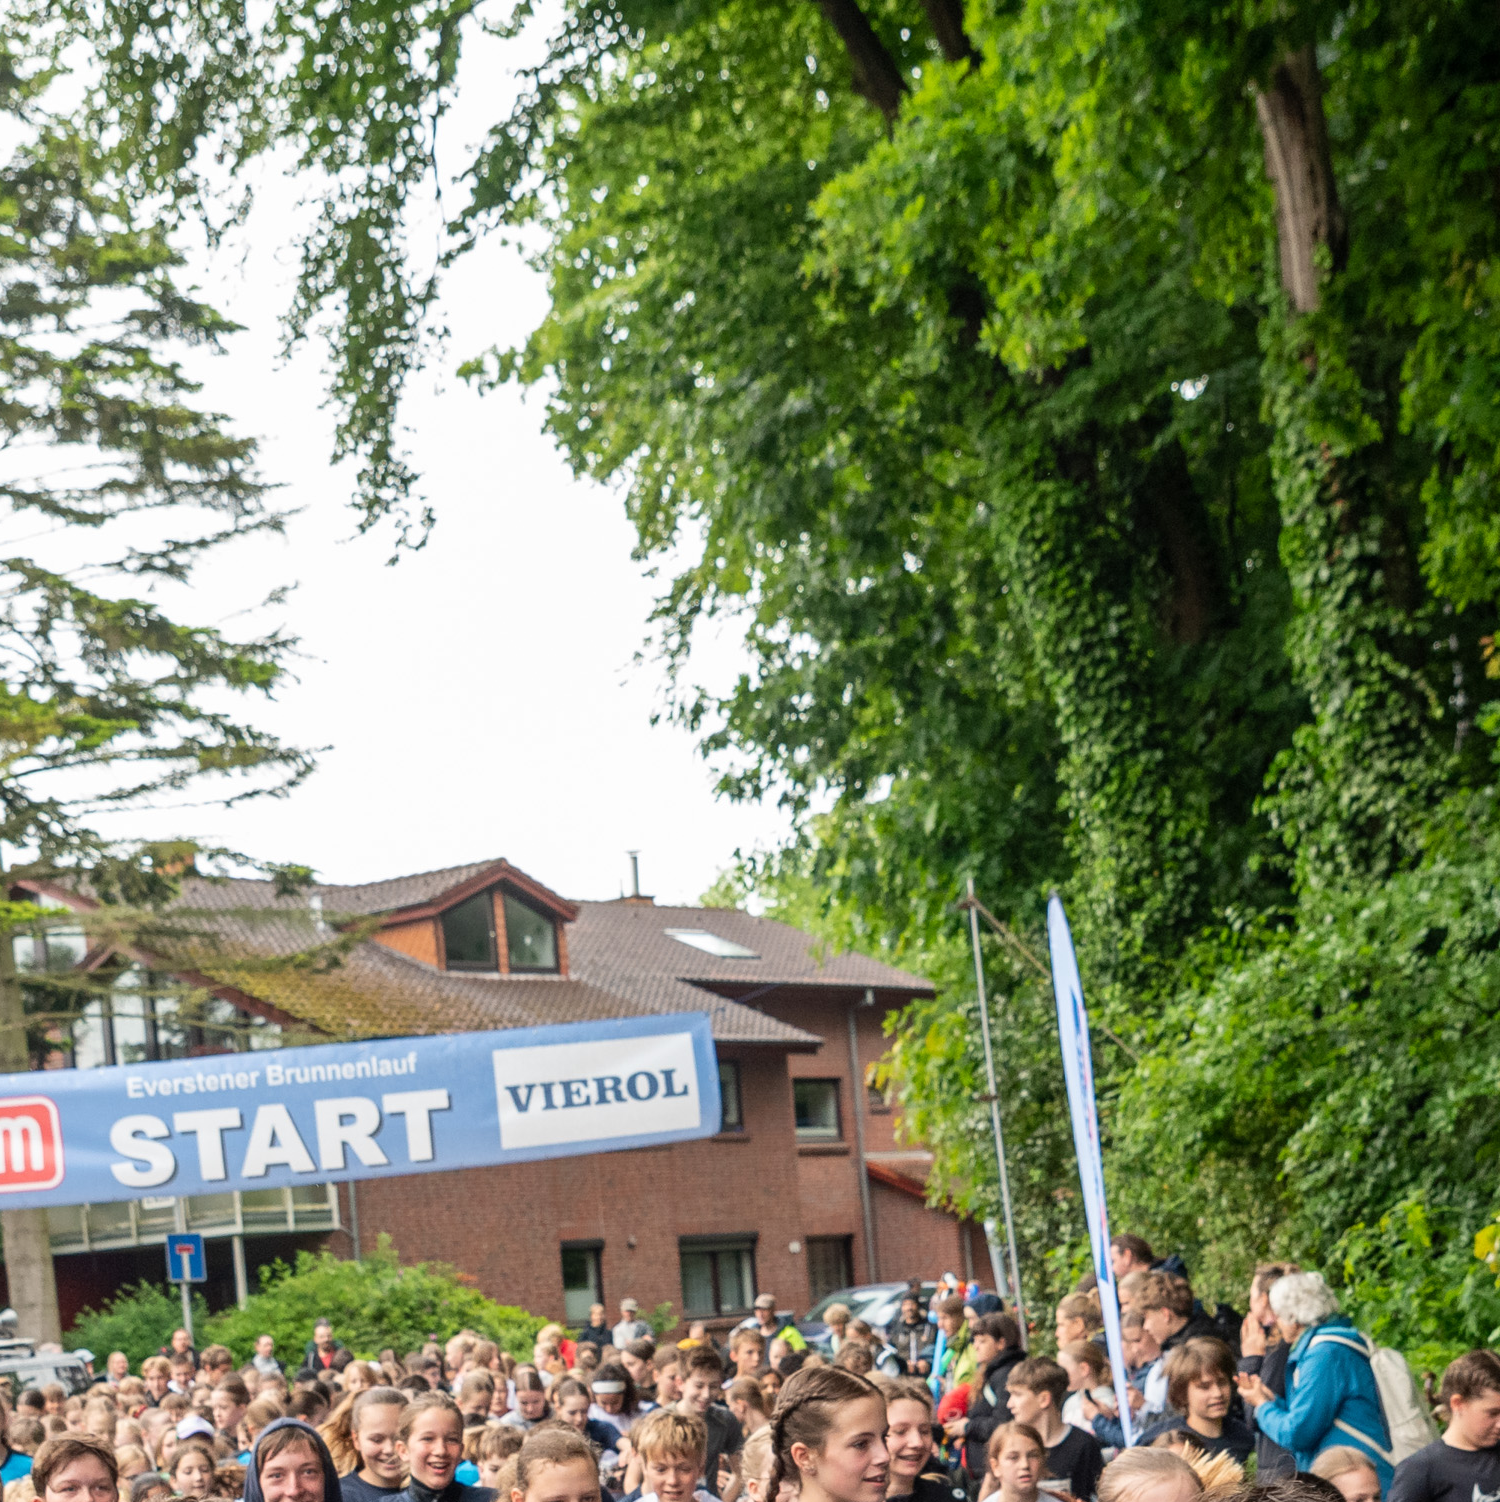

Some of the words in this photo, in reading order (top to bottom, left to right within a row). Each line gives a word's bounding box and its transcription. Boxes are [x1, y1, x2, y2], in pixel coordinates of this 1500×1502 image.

[126, 1069, 260, 1099] Everstener
[266, 1052, 418, 1088] Brunnenlauf
[504, 1068, 689, 1113] VIEROL
[109, 1088, 452, 1189] START
